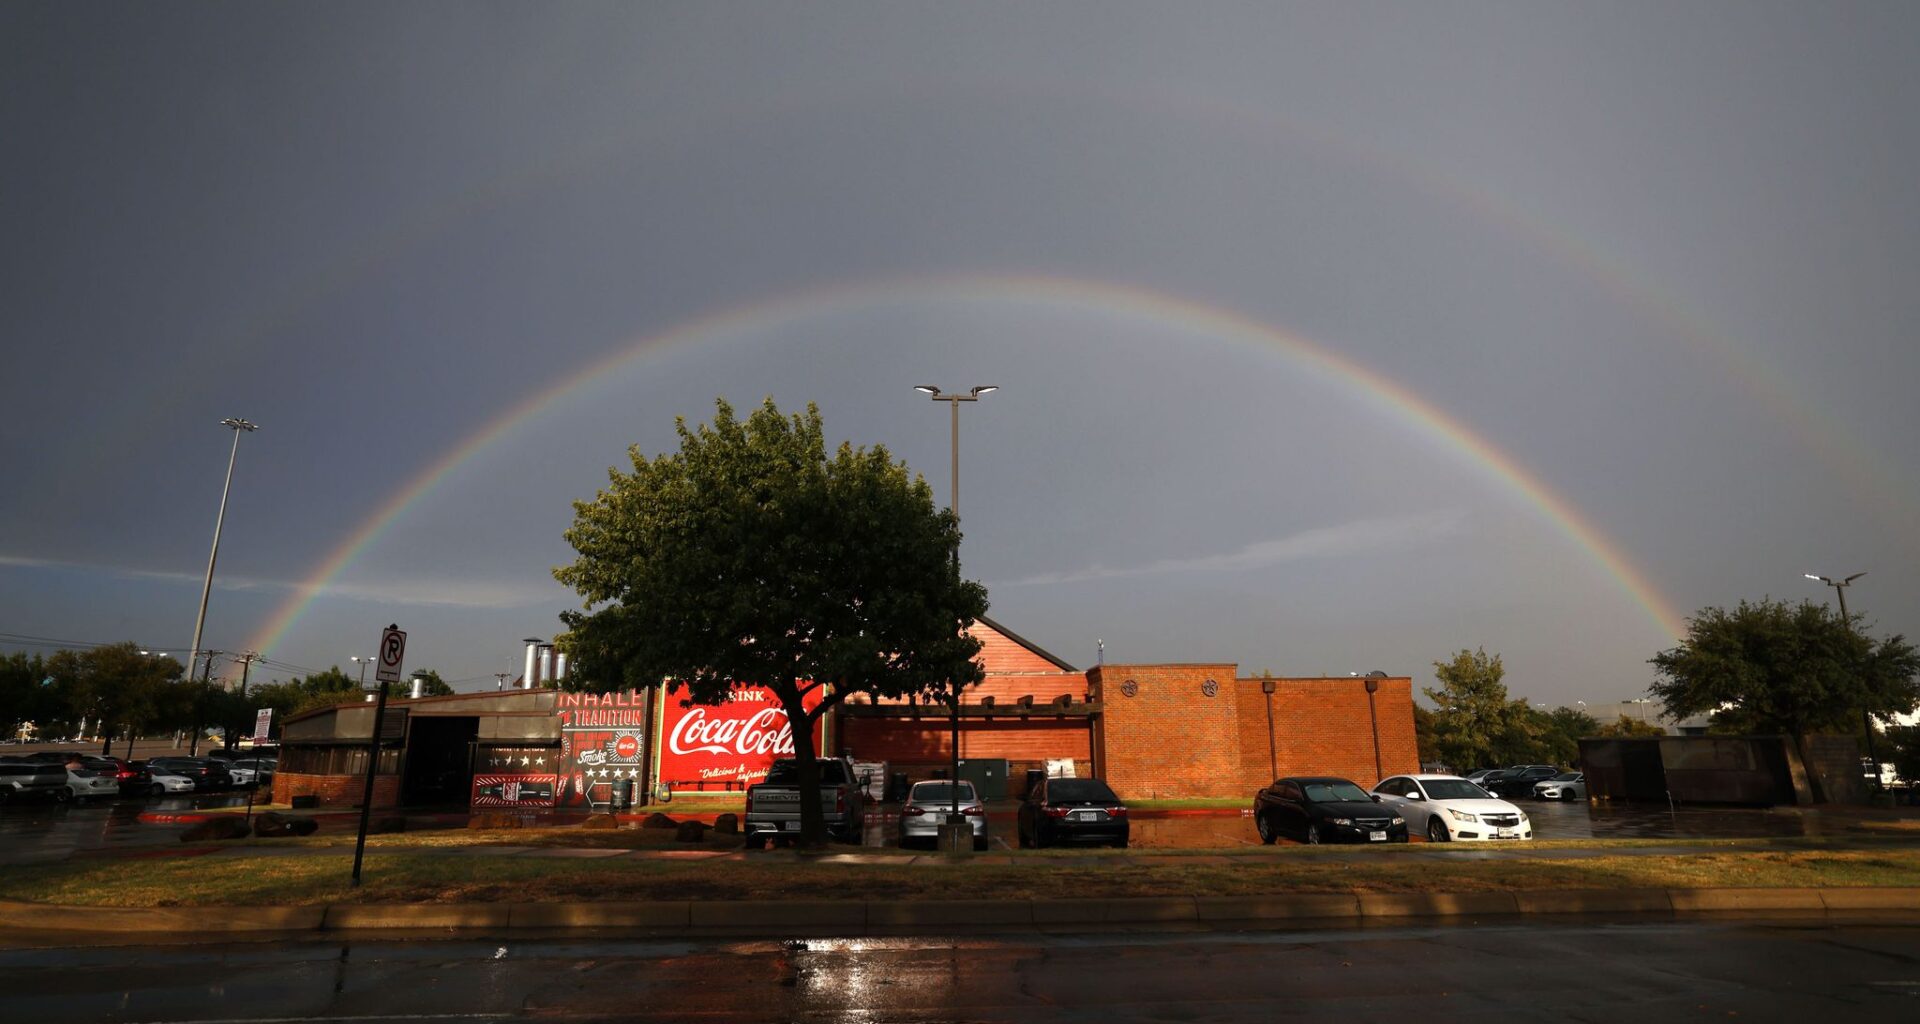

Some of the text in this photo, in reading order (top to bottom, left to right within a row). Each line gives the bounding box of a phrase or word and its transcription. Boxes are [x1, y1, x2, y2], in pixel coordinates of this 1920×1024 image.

[557, 689, 644, 707] INHALE
[574, 709, 642, 726] TRADITION
[577, 749, 608, 766] Smoke
